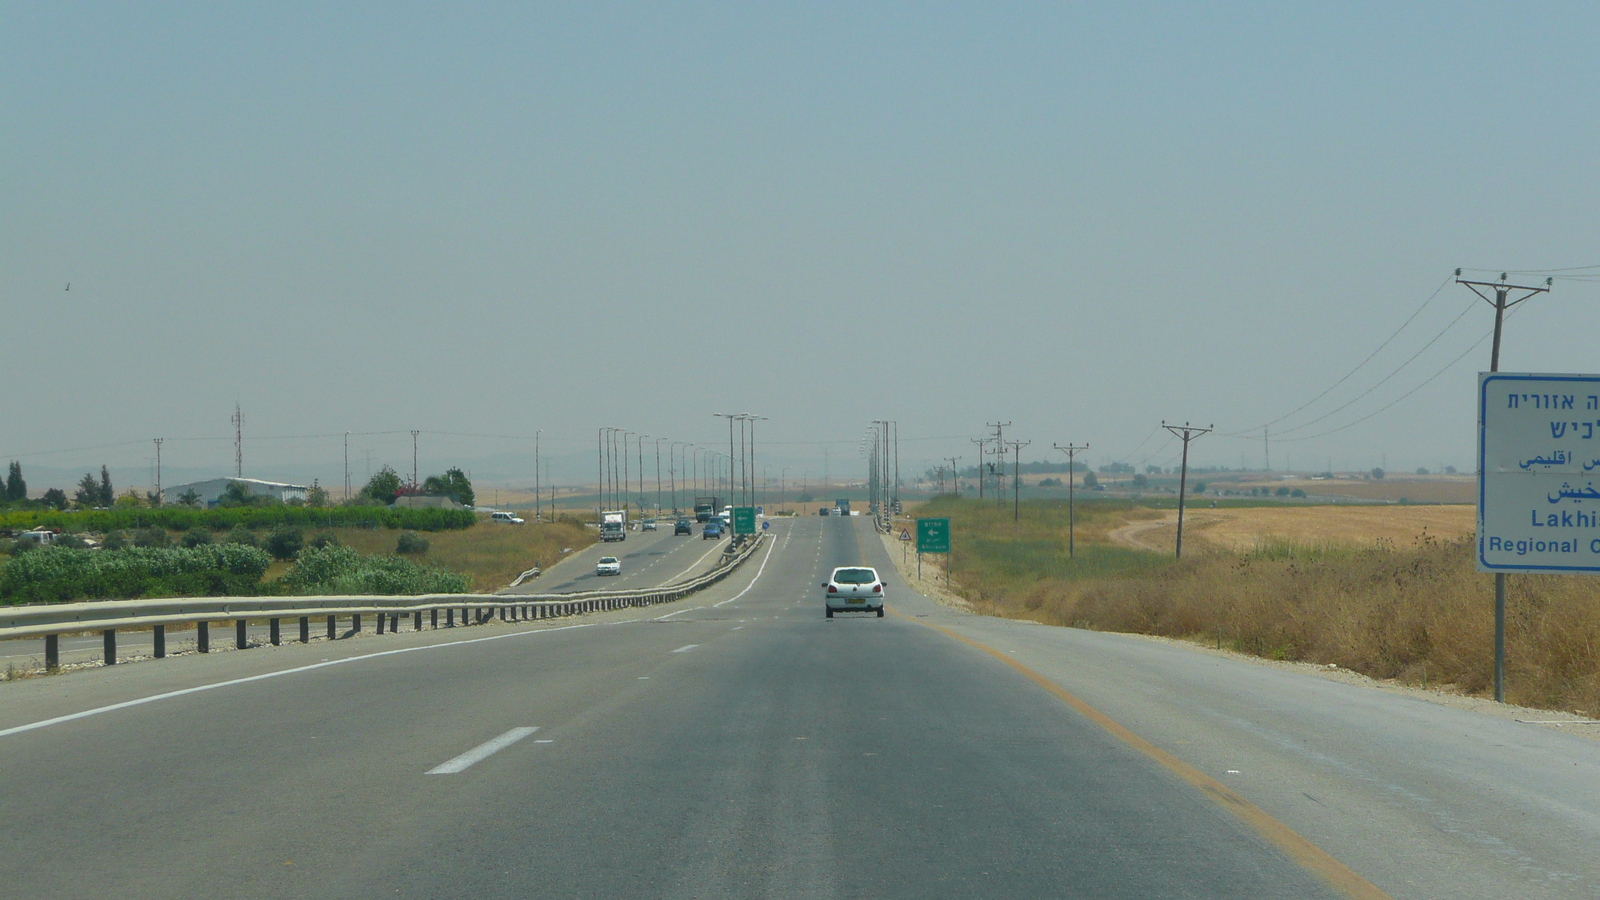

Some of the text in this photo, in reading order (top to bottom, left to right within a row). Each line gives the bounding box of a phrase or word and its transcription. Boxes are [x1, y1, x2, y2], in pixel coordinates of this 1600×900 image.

[1508, 394, 1574, 410] אזורית
[1531, 509, 1600, 528] Lakhi
[1489, 536, 1578, 555] Regional
